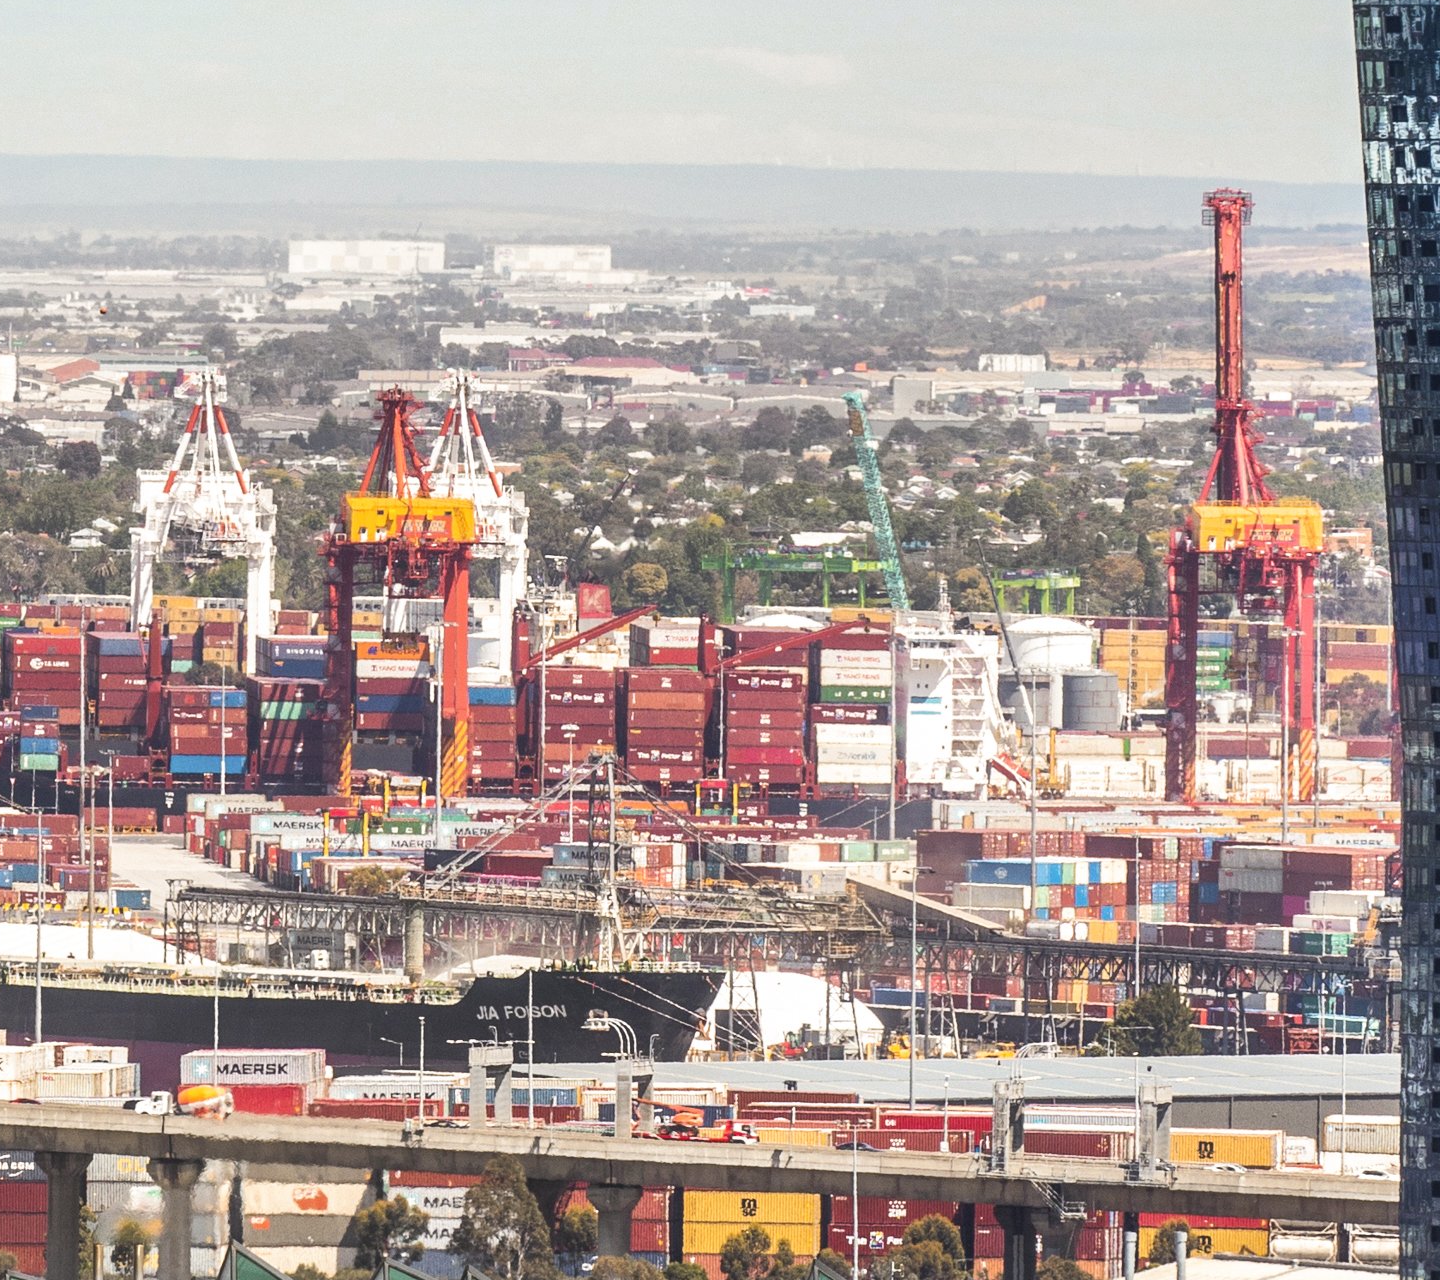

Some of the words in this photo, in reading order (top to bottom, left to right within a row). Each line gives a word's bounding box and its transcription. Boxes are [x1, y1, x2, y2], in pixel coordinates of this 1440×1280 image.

[273, 821, 322, 830] MAERSK
[476, 1005, 499, 1020] JIA
[216, 1063, 288, 1075] MAERSK
